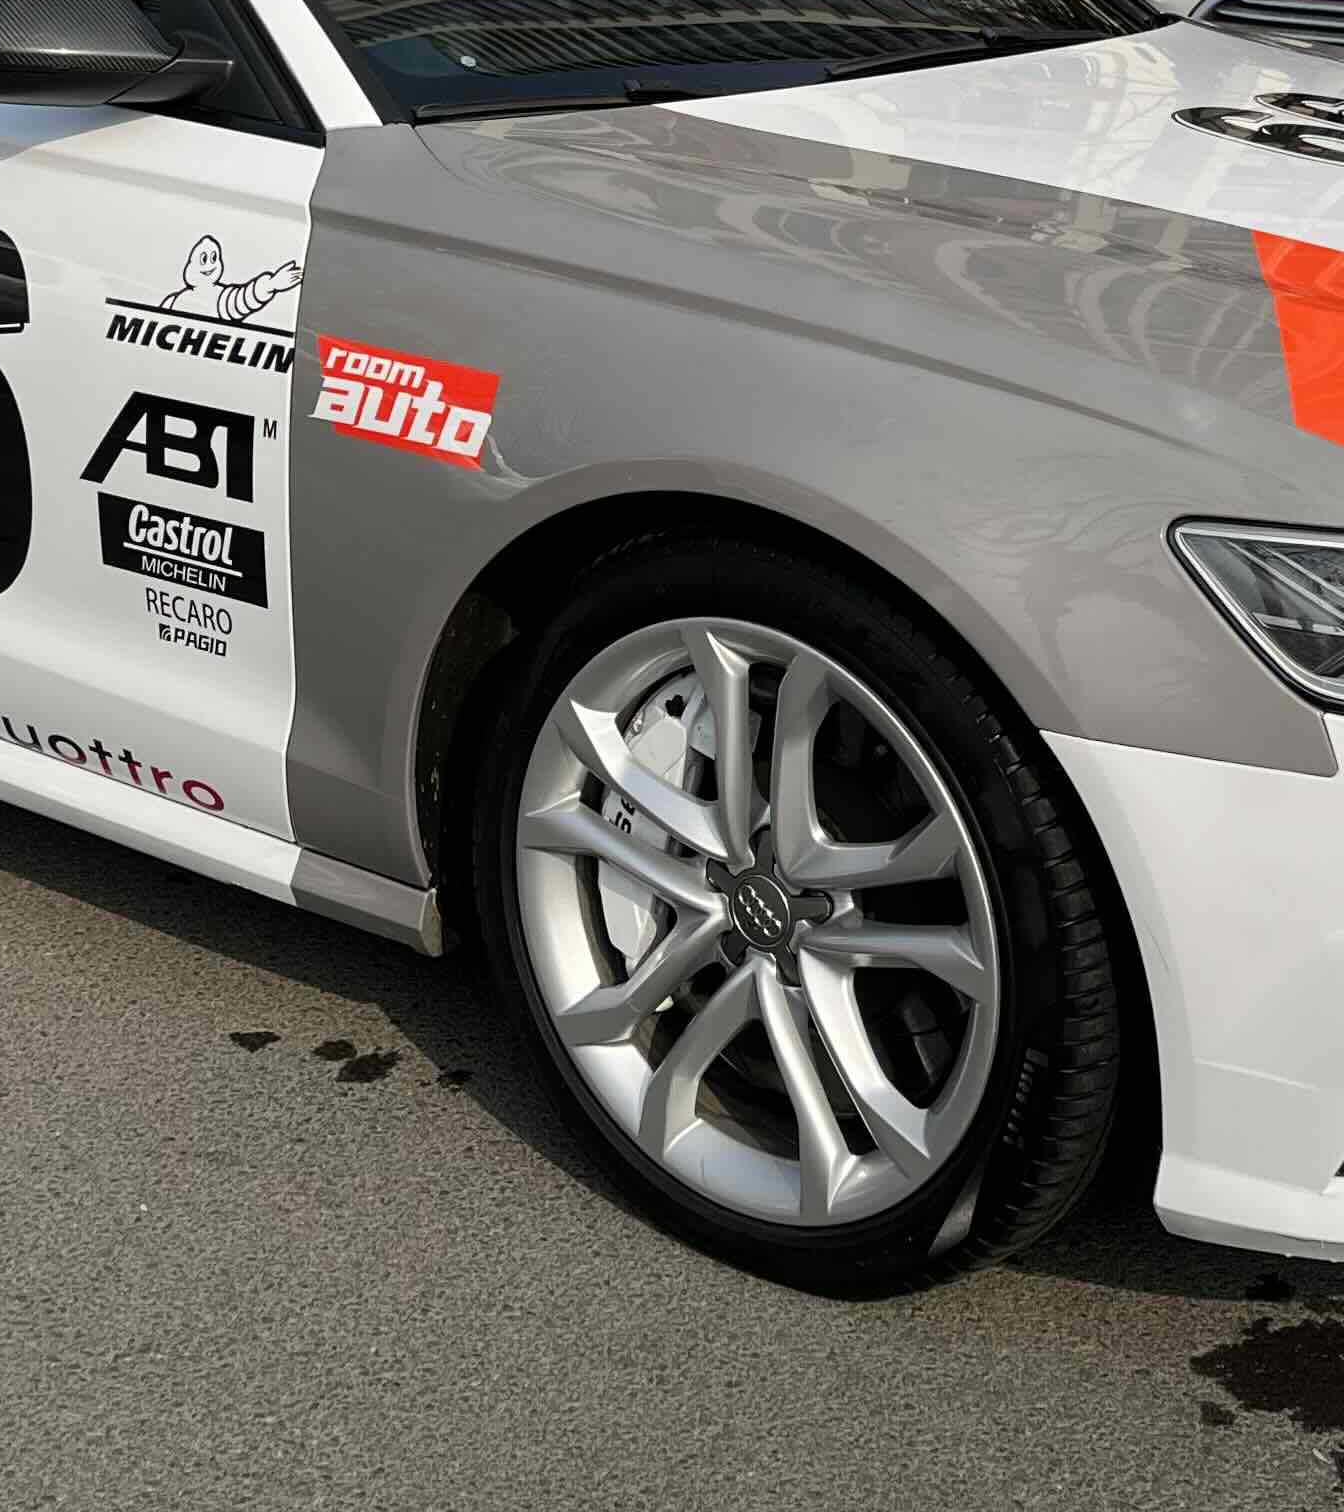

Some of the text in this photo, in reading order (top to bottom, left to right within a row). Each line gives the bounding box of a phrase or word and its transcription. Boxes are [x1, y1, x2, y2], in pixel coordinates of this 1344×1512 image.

[105, 313, 295, 374] MICHELIN
[325, 346, 426, 389] room
[79, 390, 256, 504] ABT
[306, 375, 493, 458] auto
[127, 503, 234, 566] Castrol
[140, 554, 227, 593] MICHELIN
[144, 586, 233, 635] RECARO
